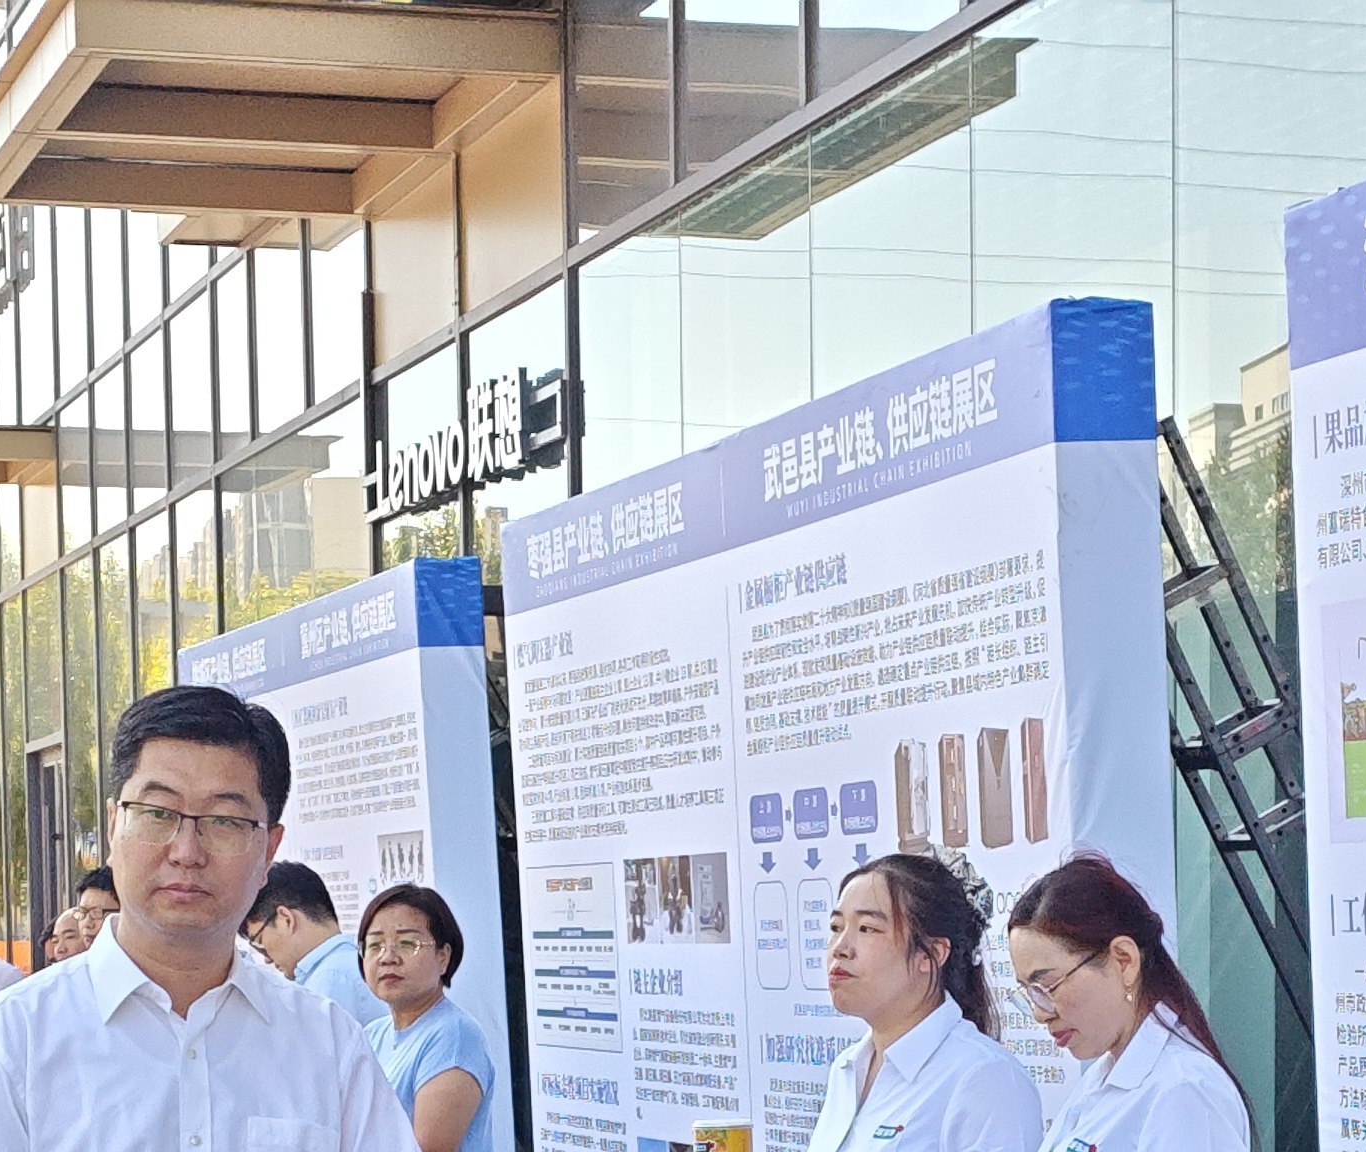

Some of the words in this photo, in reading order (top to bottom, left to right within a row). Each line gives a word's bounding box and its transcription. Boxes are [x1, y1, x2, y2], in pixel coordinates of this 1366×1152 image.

[466, 367, 523, 482] 联想
[763, 358, 998, 503] 武邑县产业链、供应链展区
[526, 481, 685, 579] 枣强县产业链、供应链展区
